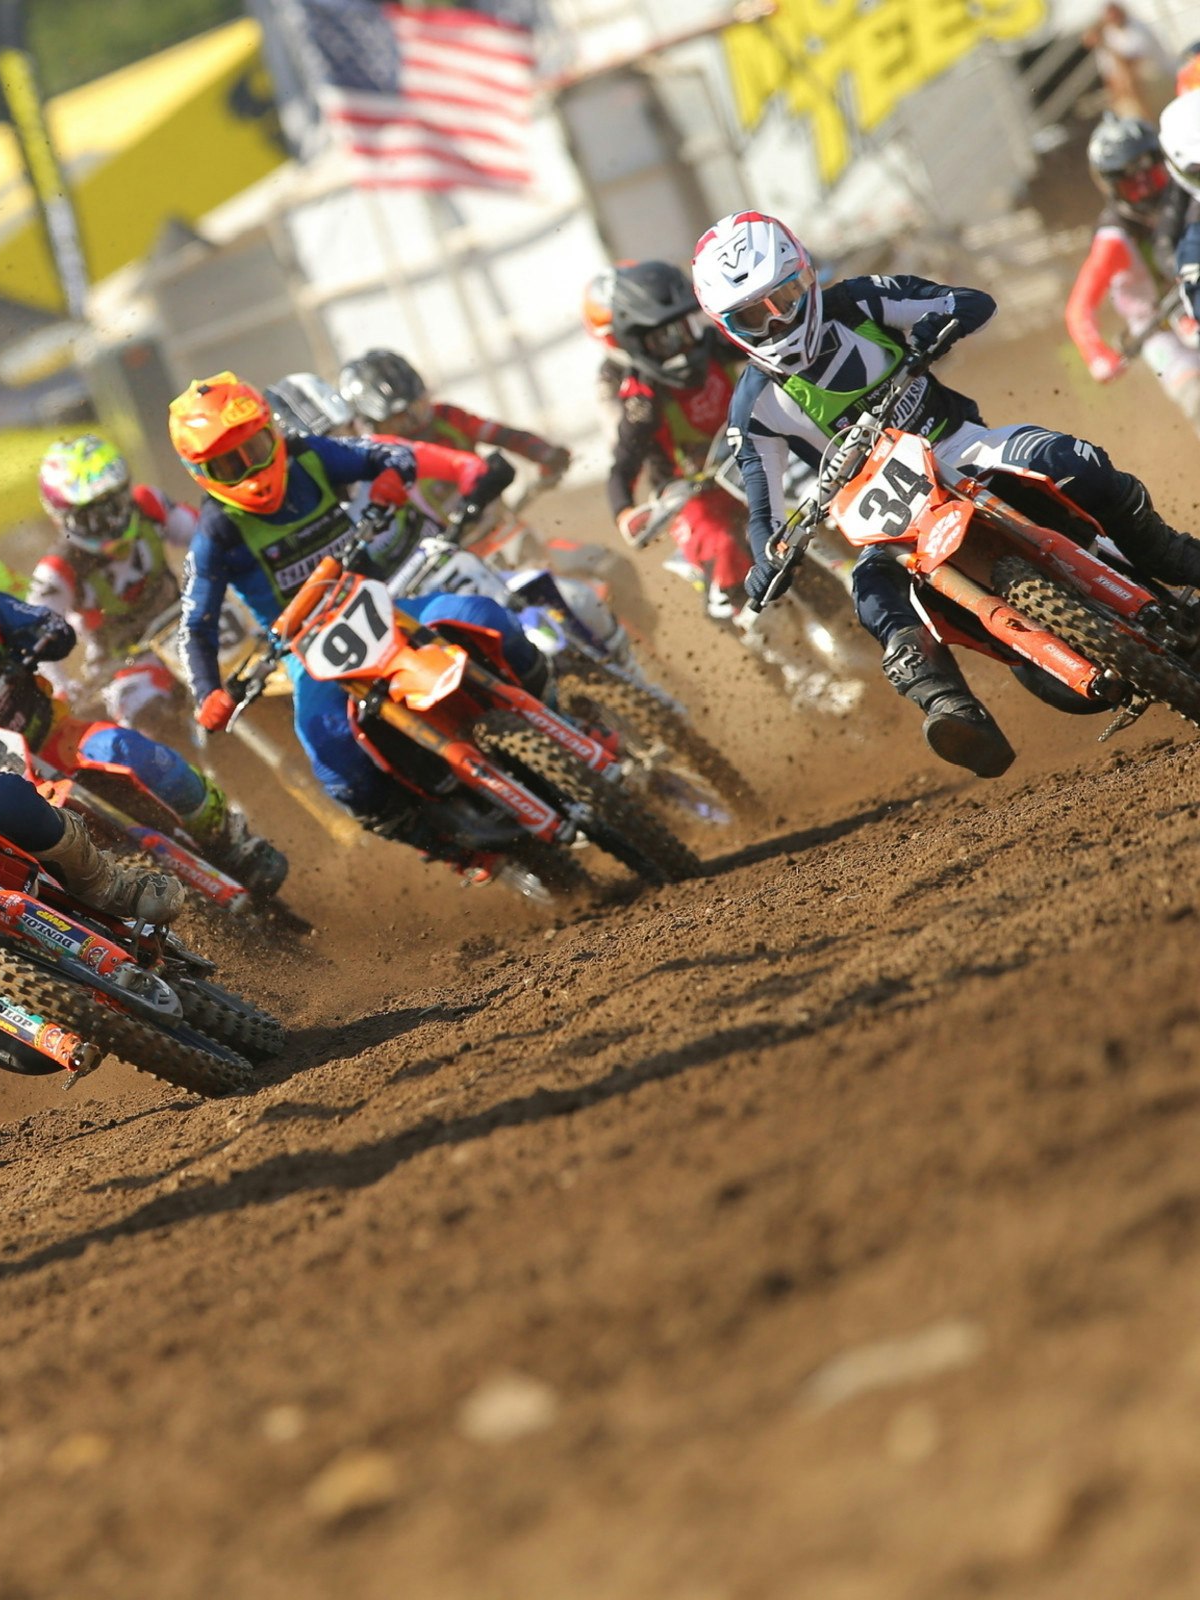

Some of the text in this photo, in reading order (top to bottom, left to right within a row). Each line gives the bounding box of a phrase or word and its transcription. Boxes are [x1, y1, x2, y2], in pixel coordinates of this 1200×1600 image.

[858, 457, 936, 538] 34
[322, 587, 389, 673] 97
[22, 913, 74, 950] DUNLOP
